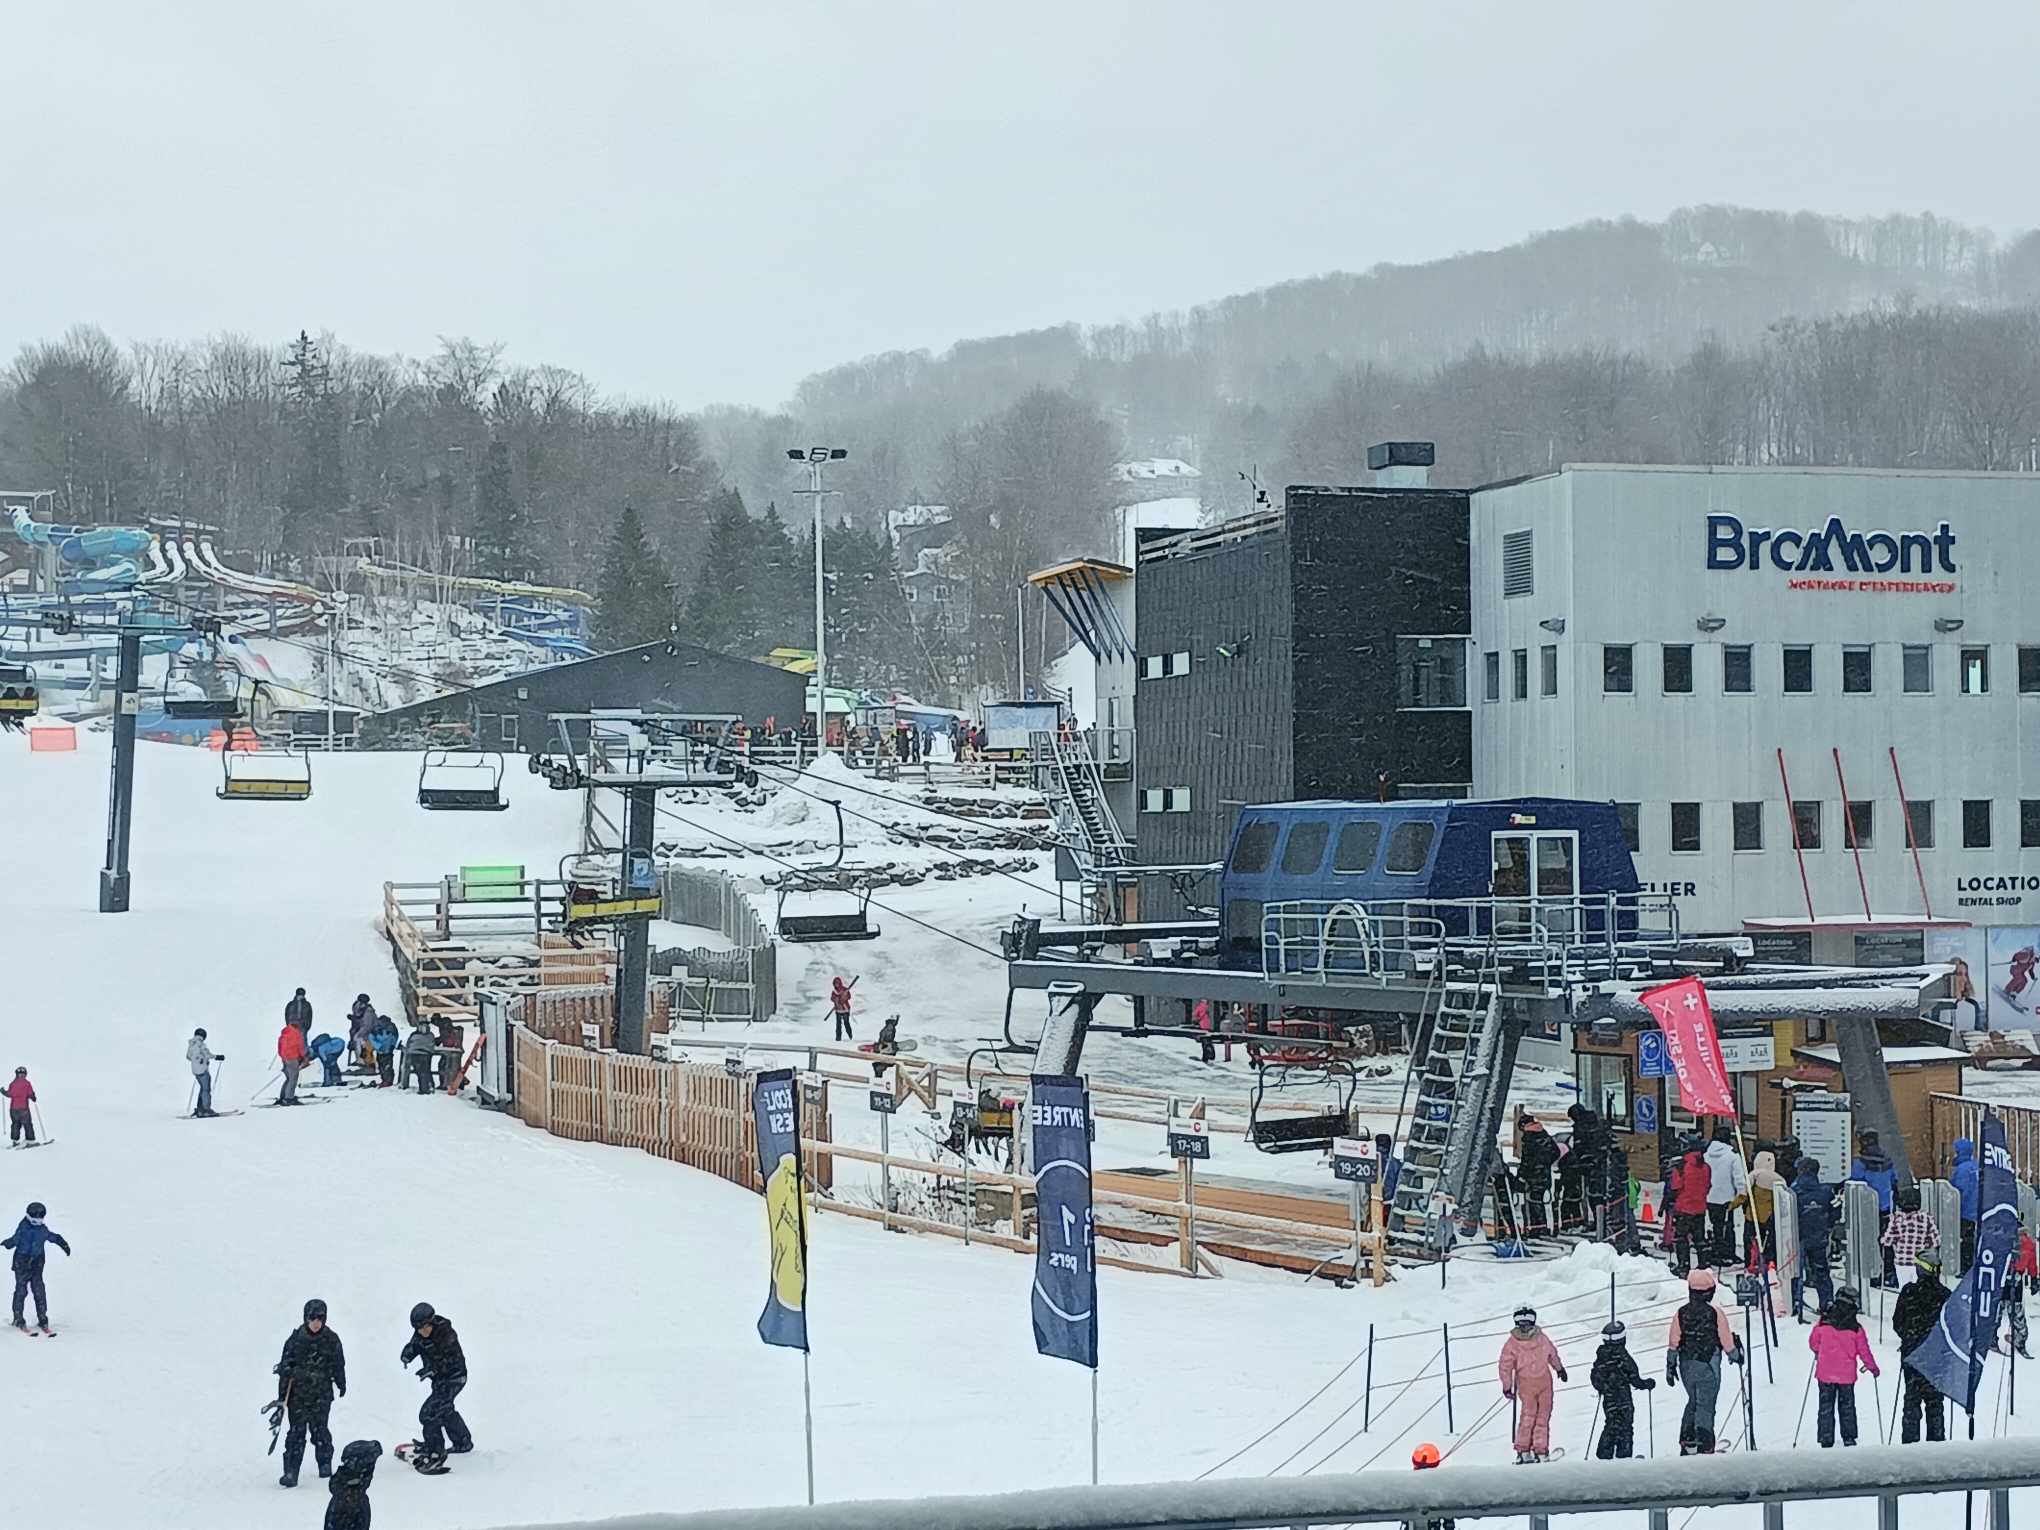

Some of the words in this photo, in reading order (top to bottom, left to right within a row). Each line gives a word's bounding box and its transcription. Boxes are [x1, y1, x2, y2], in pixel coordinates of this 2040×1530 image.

[1957, 876, 2040, 891] LOCATIO
[1958, 897, 1994, 906] RENTAL
[1995, 896, 2022, 906] SHOP
[1176, 1139, 1202, 1153] 17-18
[1340, 1162, 1371, 1177] 19-20
